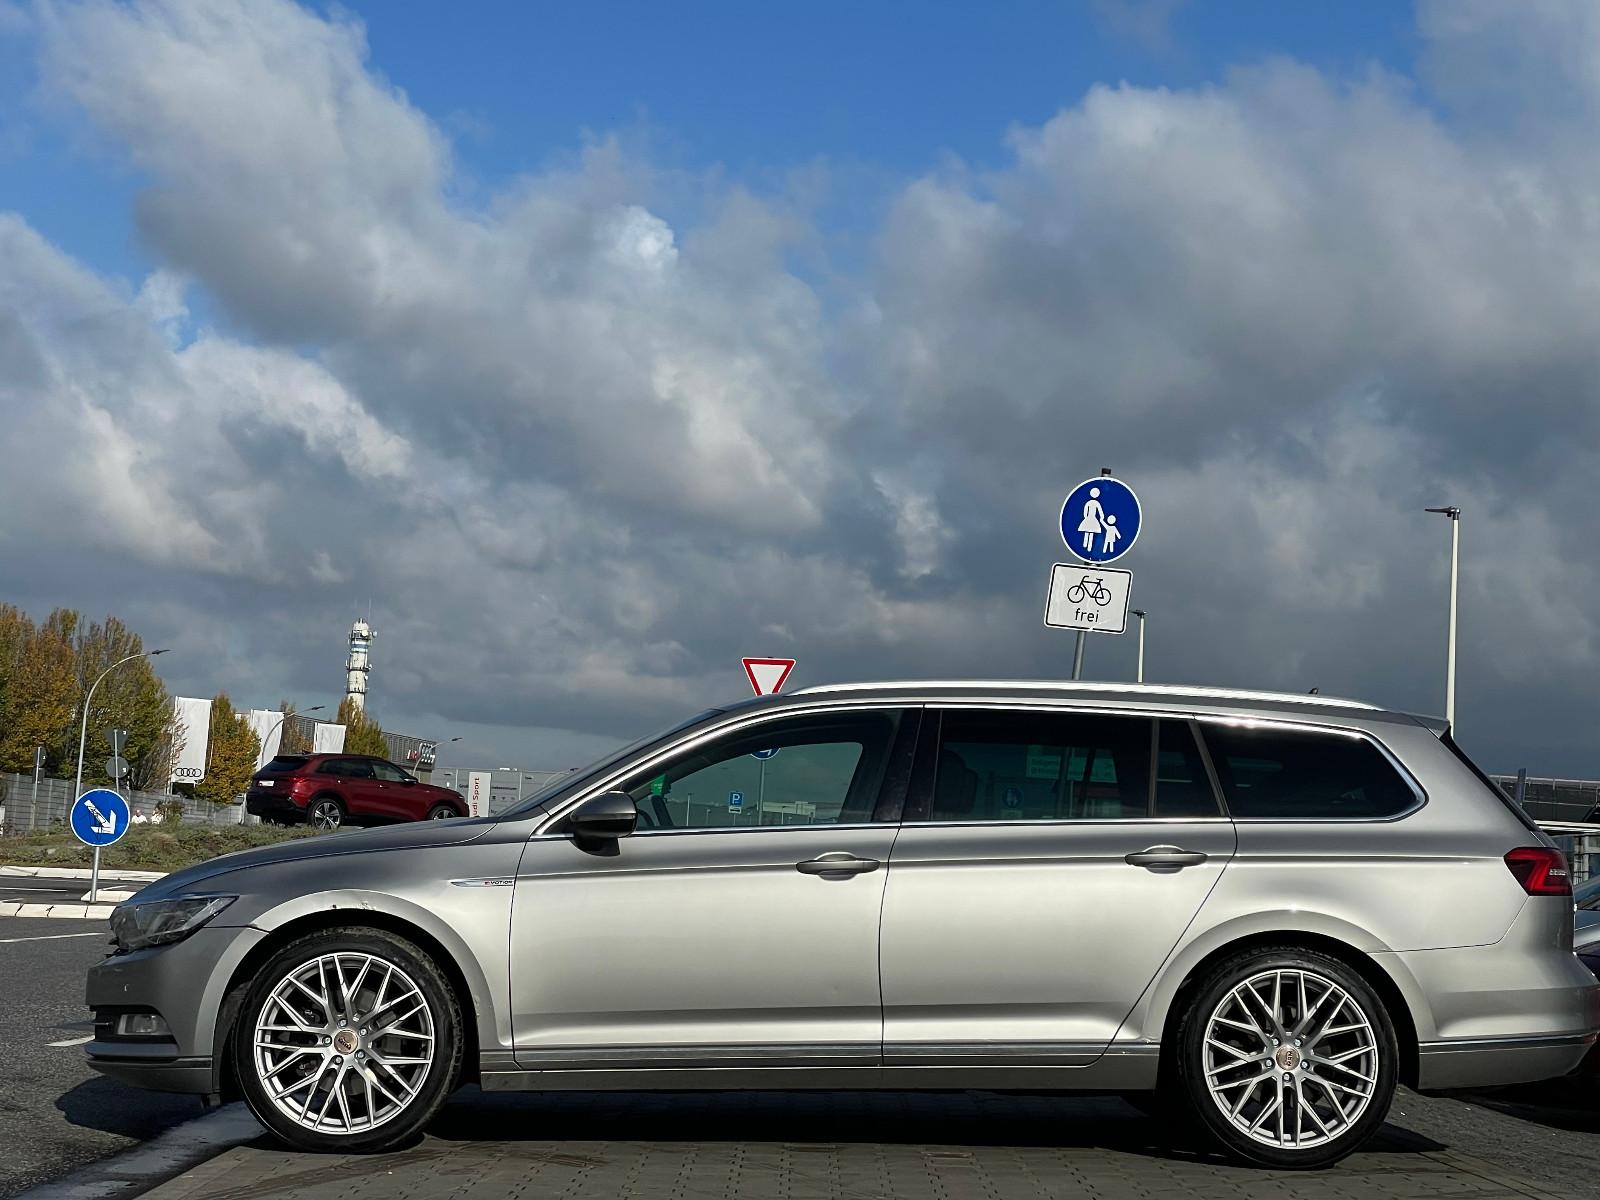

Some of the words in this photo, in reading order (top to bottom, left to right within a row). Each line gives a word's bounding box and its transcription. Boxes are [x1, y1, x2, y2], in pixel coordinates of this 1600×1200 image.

[1075, 607, 1100, 623] frei
[472, 777, 480, 800] Sport
[732, 793, 741, 805] P
